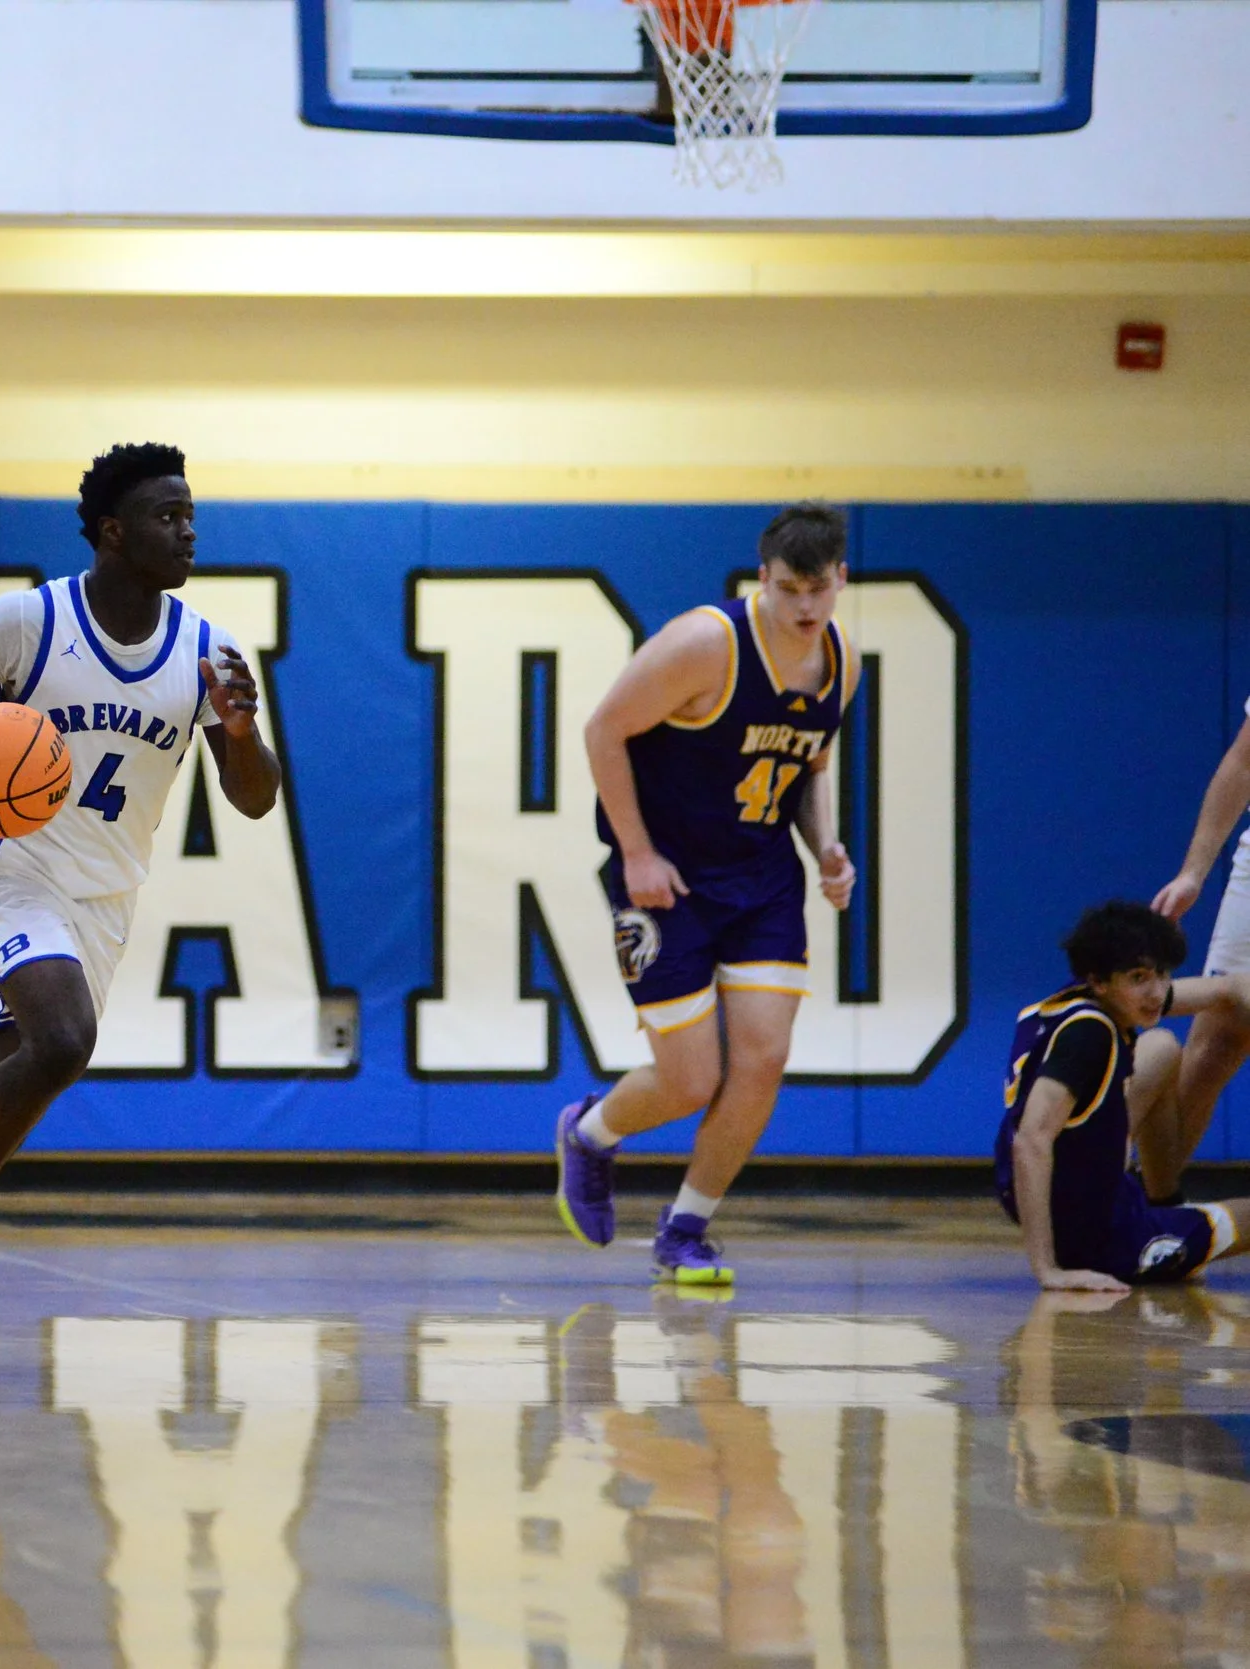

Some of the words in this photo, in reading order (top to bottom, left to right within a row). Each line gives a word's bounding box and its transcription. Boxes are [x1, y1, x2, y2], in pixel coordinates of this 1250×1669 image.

[48, 703, 178, 750] BREVARD
[77, 752, 126, 822] 4
[734, 757, 802, 825] 41
[0, 933, 30, 964] B
